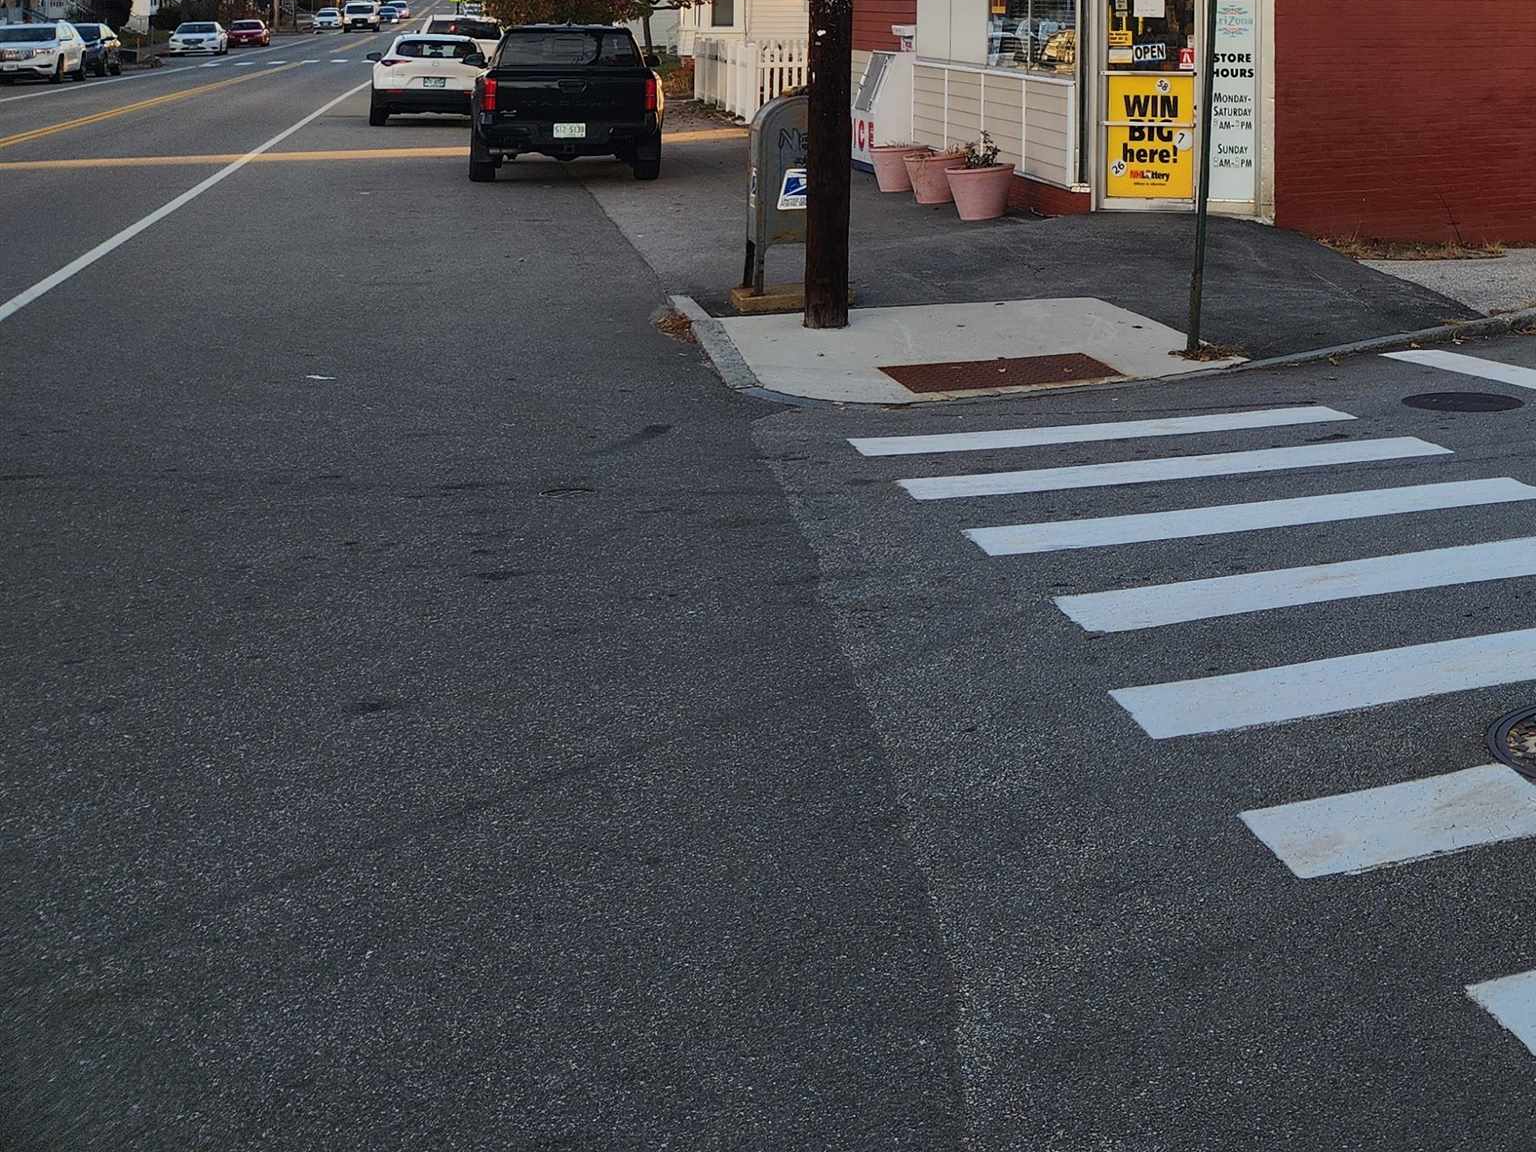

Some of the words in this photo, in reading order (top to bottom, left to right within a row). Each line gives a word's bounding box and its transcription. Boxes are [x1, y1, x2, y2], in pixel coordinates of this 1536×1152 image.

[1134, 44, 1165, 60] OPEN
[1213, 53, 1252, 63] STORE
[1212, 68, 1254, 78] HOURS
[1123, 94, 1179, 118] WIN
[1213, 105, 1252, 117] SATURDAY
[854, 118, 874, 151] ICE
[1128, 118, 1174, 143] BIG
[1122, 142, 1179, 164] here!
[1217, 143, 1249, 154] SUNDAY
[1111, 161, 1126, 175] 26
